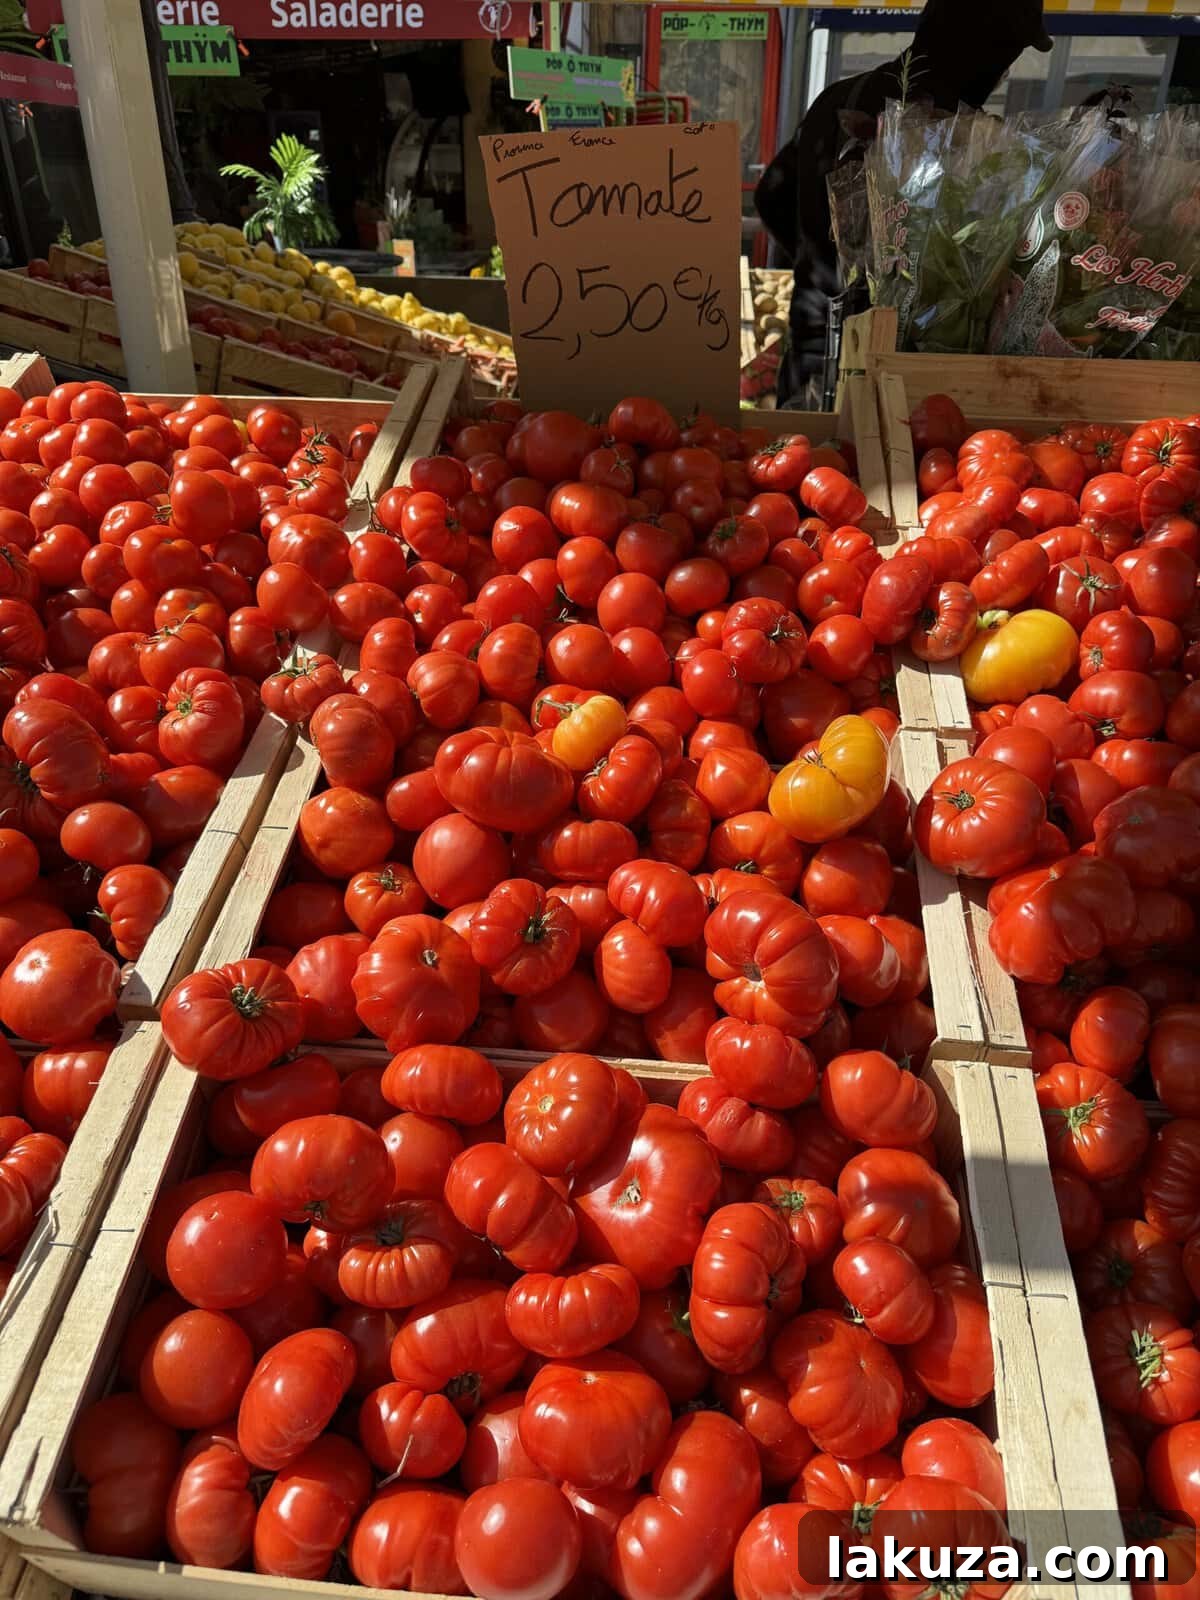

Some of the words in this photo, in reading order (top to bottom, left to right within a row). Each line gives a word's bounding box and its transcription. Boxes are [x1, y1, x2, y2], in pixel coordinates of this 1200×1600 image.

[156, 0, 220, 25] erie
[271, 0, 424, 28] Saladerie
[496, 148, 712, 238] Tomate
[1071, 244, 1120, 274] Les
[1115, 257, 1190, 297] Herb
